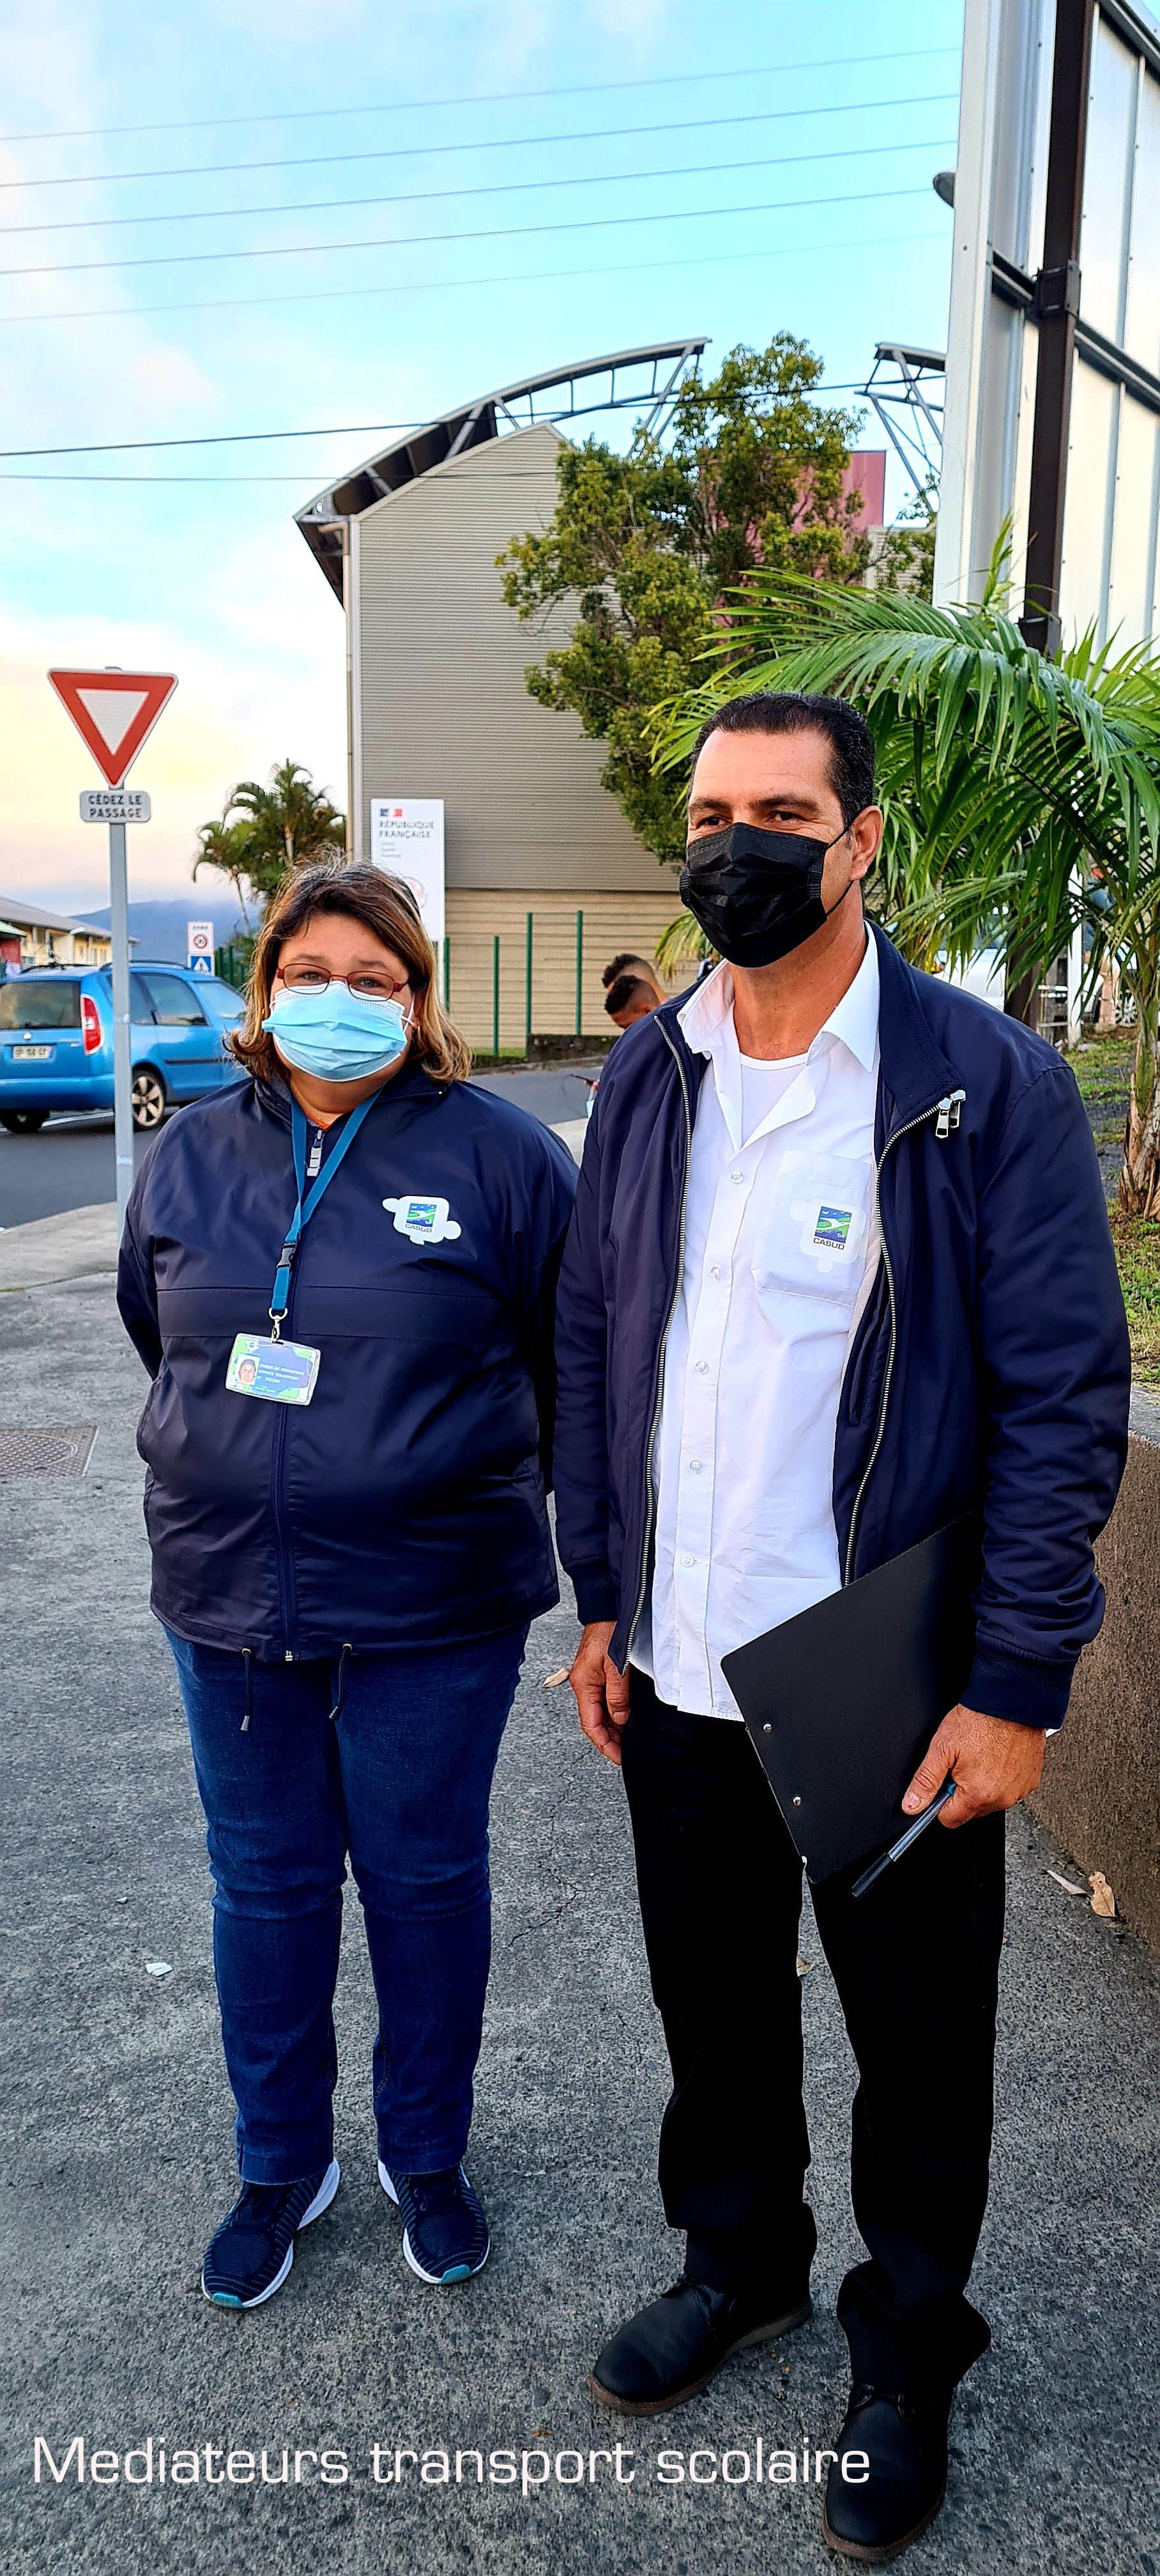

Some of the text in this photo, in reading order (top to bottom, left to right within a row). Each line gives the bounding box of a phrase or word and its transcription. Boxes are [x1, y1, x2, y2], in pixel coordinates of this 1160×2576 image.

[88, 793, 142, 805] CÉDEZ LE
[89, 808, 142, 818] PASSAGE
[379, 820, 434, 829] RÉPUBLIQUE
[379, 830, 430, 838] FRANÇAISE
[405, 1224, 432, 1233] CASUD
[813, 1238, 845, 1250] CASUD
